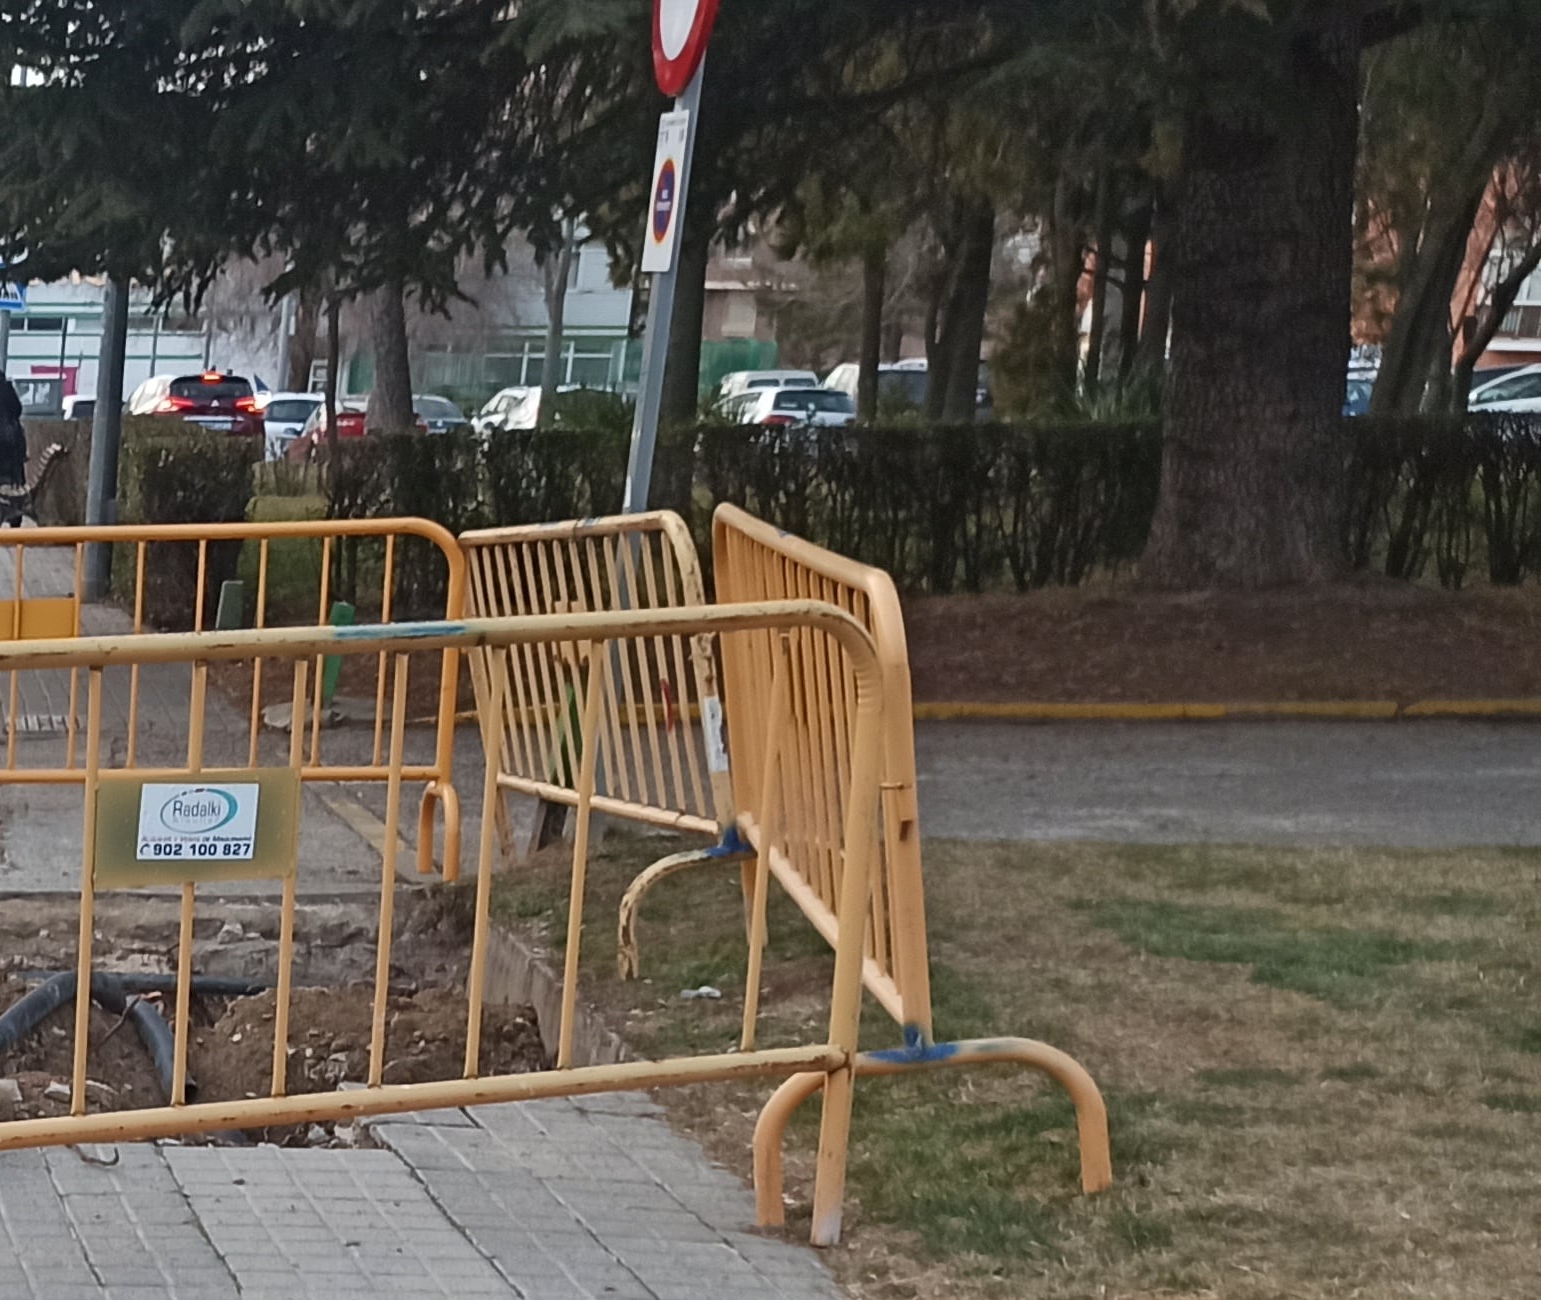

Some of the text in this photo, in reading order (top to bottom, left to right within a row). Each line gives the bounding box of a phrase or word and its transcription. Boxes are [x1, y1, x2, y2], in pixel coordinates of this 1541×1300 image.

[172, 799, 221, 817] Radalki
[153, 843, 251, 856] 902 100 827
